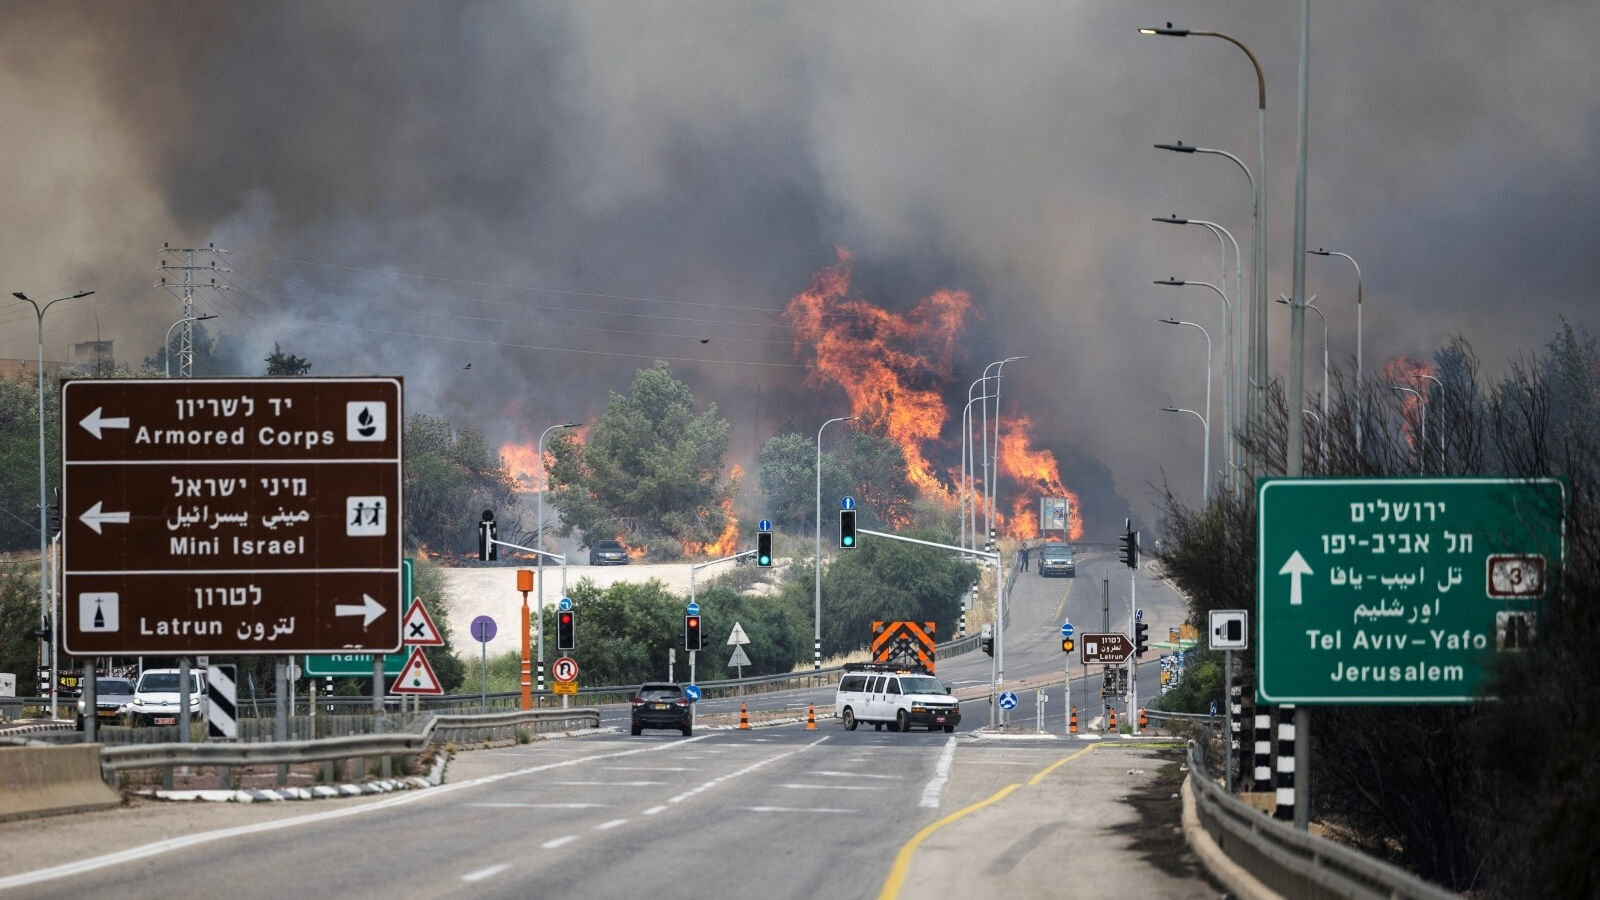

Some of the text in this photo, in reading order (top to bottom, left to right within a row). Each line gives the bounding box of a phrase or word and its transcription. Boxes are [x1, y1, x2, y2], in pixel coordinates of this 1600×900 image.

[176, 396, 292, 420] יד לשריון
[135, 426, 335, 450] Armored Corps
[171, 475, 307, 497] מיני ישראל
[166, 505, 310, 531] ميني يسرائيل
[1350, 498, 1446, 523] ירושלים
[170, 535, 305, 555] Mini Israel
[1443, 530, 1473, 555] תל
[1438, 565, 1463, 593] تل
[1510, 568, 1522, 585] 3
[195, 584, 262, 609] לטרון
[140, 616, 295, 640] Latrun لترون
[1305, 630, 1342, 650] Tel
[1330, 662, 1465, 682] Jerusalem
